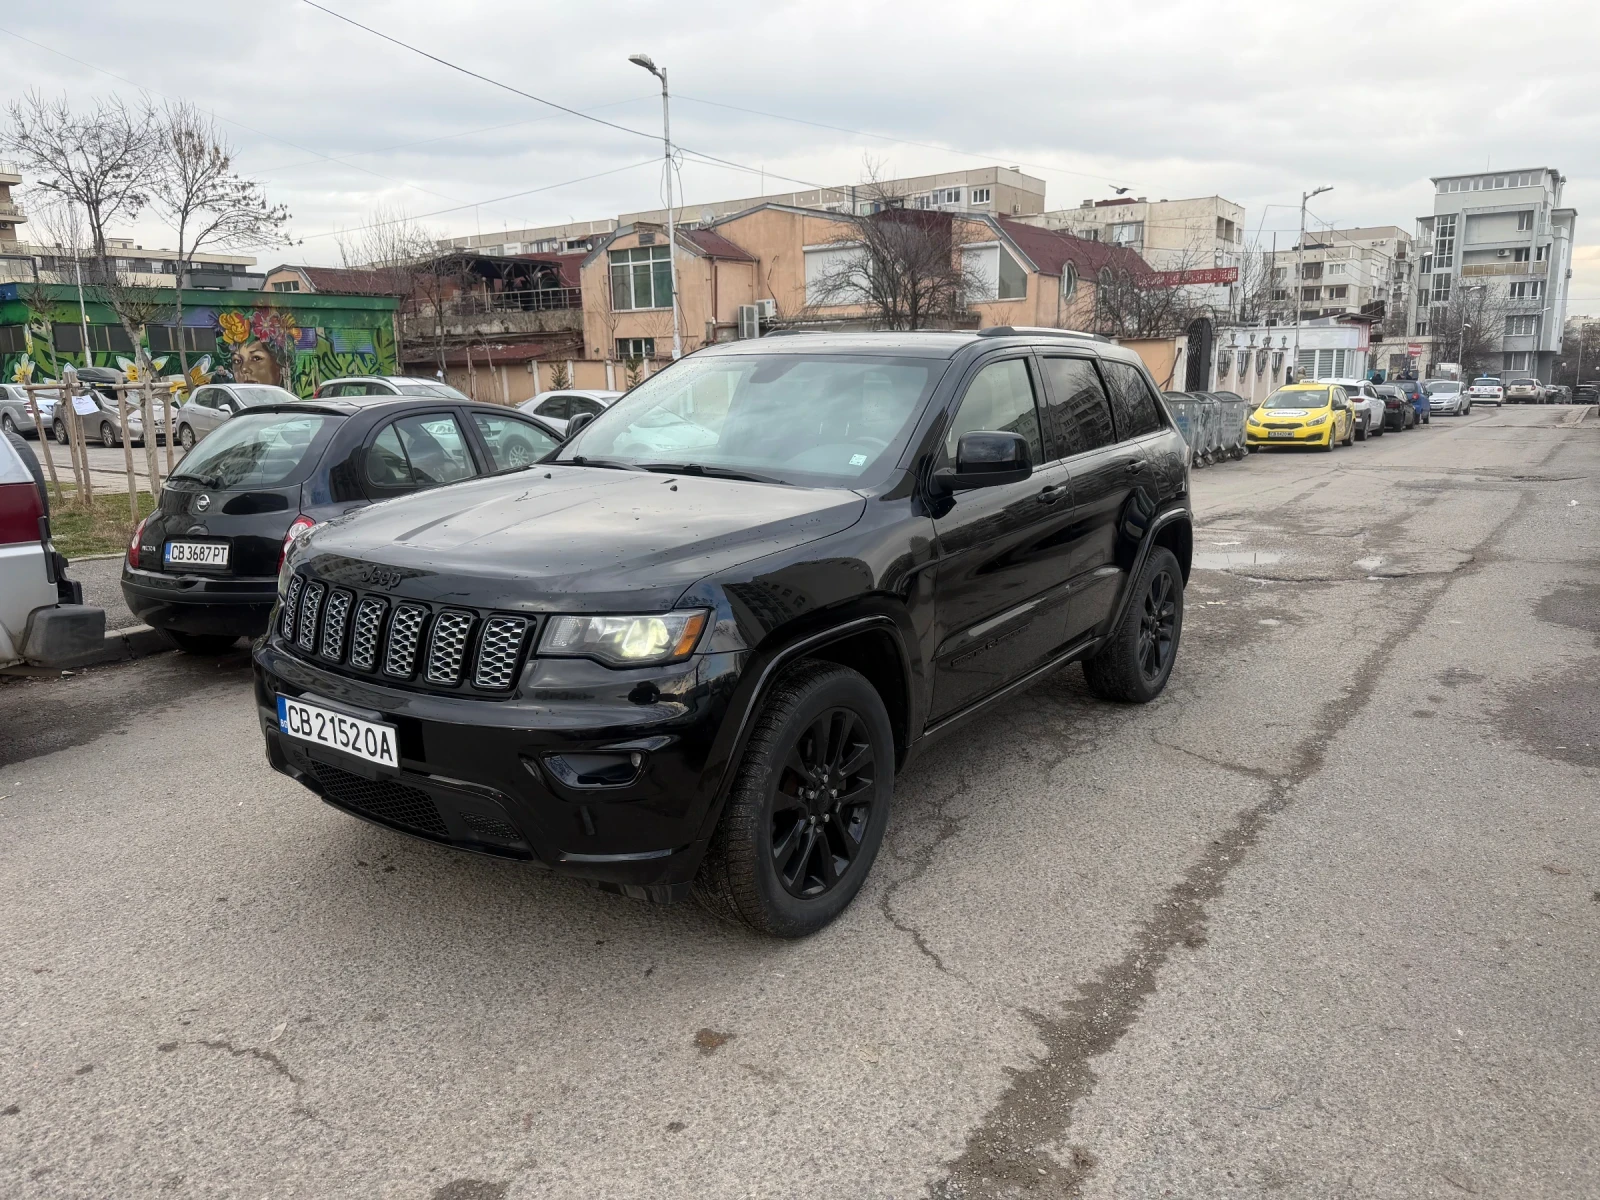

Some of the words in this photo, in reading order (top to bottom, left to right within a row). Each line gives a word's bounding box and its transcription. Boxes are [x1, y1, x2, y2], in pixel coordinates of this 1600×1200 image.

[171, 545, 185, 561] CB
[187, 546, 212, 562] 3687
[213, 547, 227, 563] PT
[361, 566, 402, 591] Jeep
